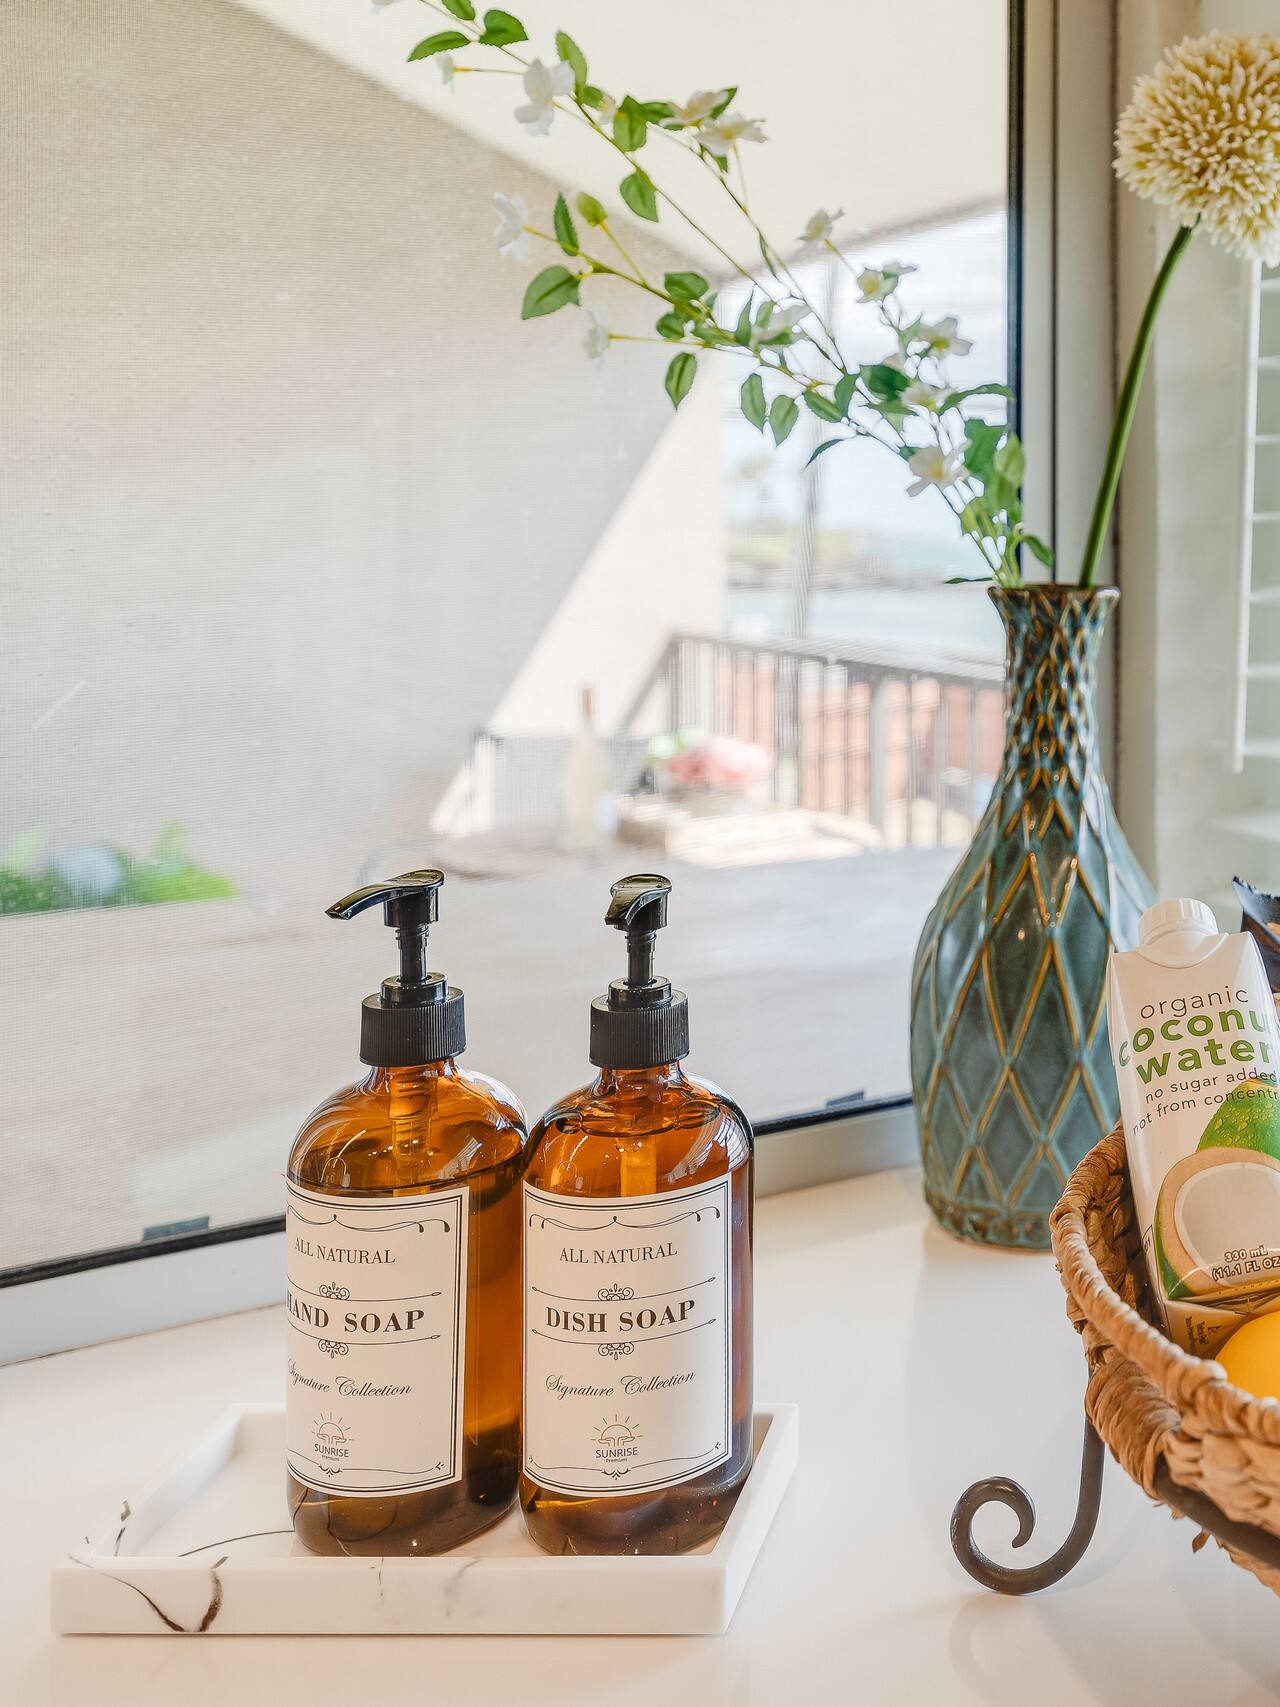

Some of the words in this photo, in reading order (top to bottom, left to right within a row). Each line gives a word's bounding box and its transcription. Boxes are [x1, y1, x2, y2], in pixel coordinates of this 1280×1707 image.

[1140, 985, 1249, 1019] organic
[1118, 1008, 1267, 1067] coconu
[1136, 1038, 1272, 1085] water
[1145, 1088, 1164, 1104] no
[1170, 1075, 1218, 1092] sugar
[1226, 1067, 1279, 1083] added
[1132, 1113, 1153, 1136] not
[1156, 1099, 1196, 1118] from
[1200, 1087, 1279, 1106] concentr
[295, 1237, 313, 1257] ALL
[317, 1244, 396, 1264] NATURAL
[560, 1247, 589, 1264] ALL
[593, 1242, 678, 1264] NATURAL
[1224, 1250, 1248, 1263] 330
[1250, 1245, 1268, 1258] mL
[1211, 1265, 1243, 1281] (11.1
[1245, 1261, 1260, 1273] FL
[344, 1309, 425, 1334] SOAP
[546, 1306, 608, 1333] DISH
[619, 1299, 695, 1332] SOAP
[288, 1358, 330, 1393] Signature
[335, 1375, 412, 1397] Collection
[546, 1374, 614, 1400] Signature
[620, 1370, 696, 1395] Collection
[314, 1443, 349, 1458] SUNRISE
[595, 1447, 638, 1459] SUNRISE
